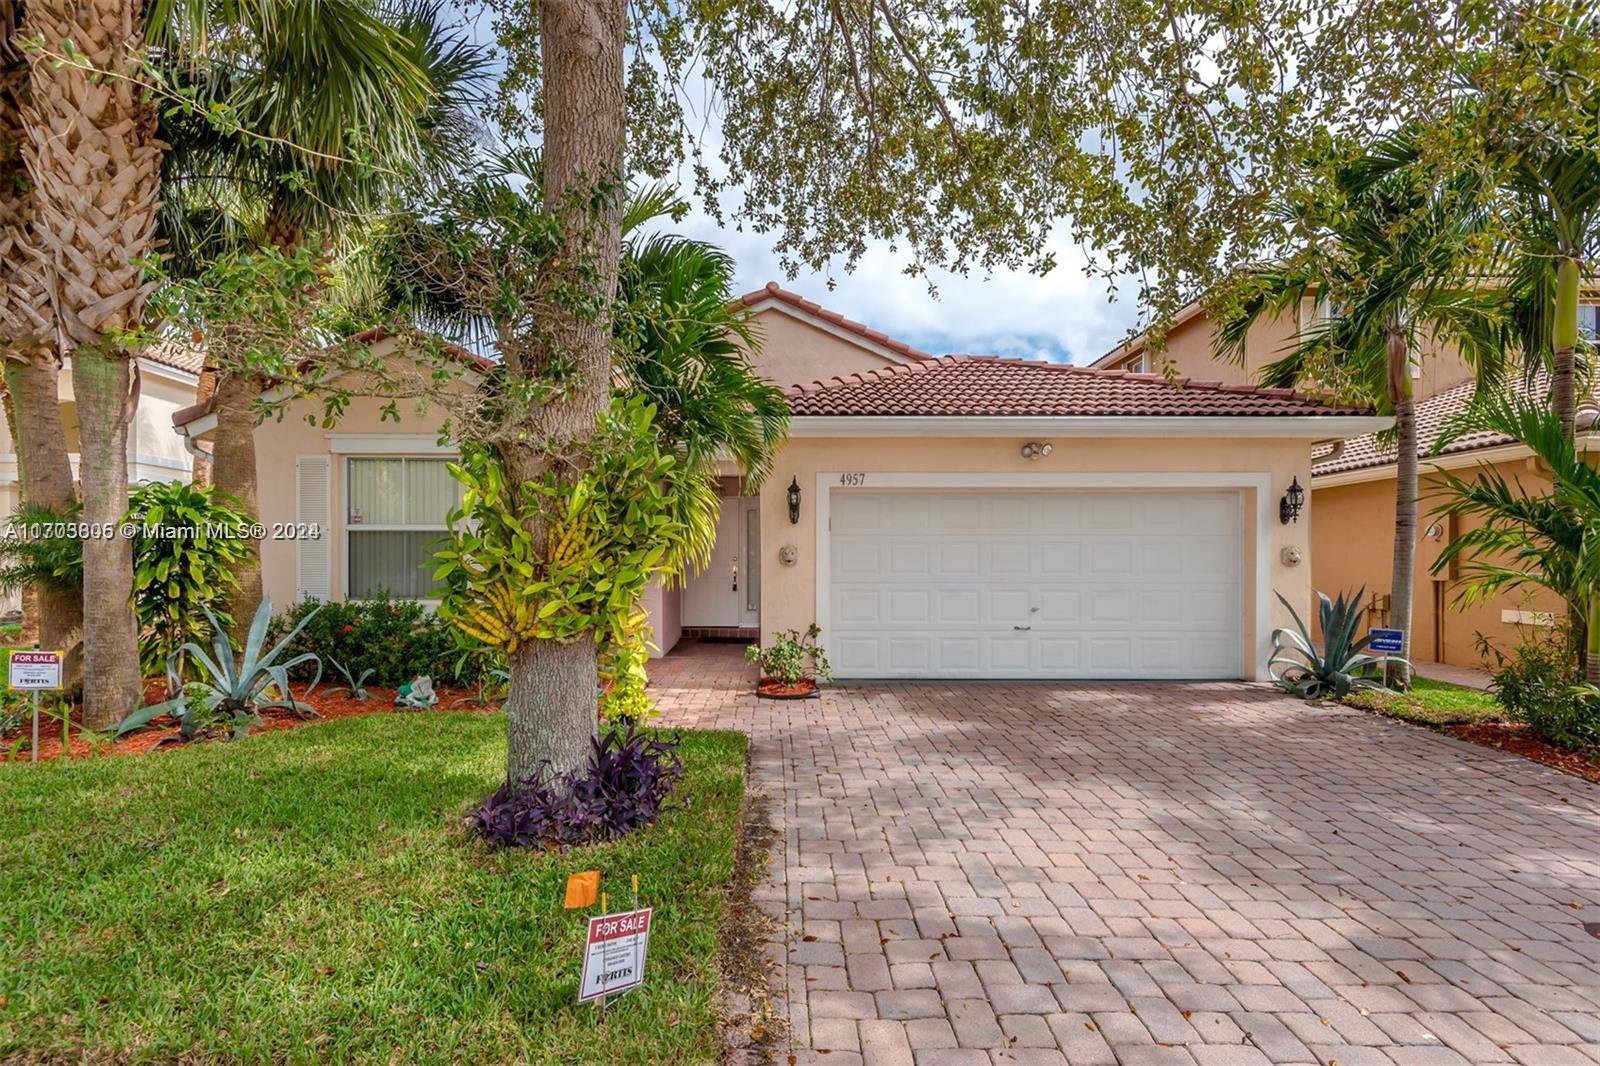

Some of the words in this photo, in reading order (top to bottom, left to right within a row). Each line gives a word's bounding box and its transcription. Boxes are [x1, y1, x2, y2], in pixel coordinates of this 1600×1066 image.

[840, 473, 865, 486] 4957
[14, 654, 32, 662] FOR
[33, 654, 56, 663] SALE
[595, 921, 618, 938] FOR
[620, 915, 646, 934] SALE
